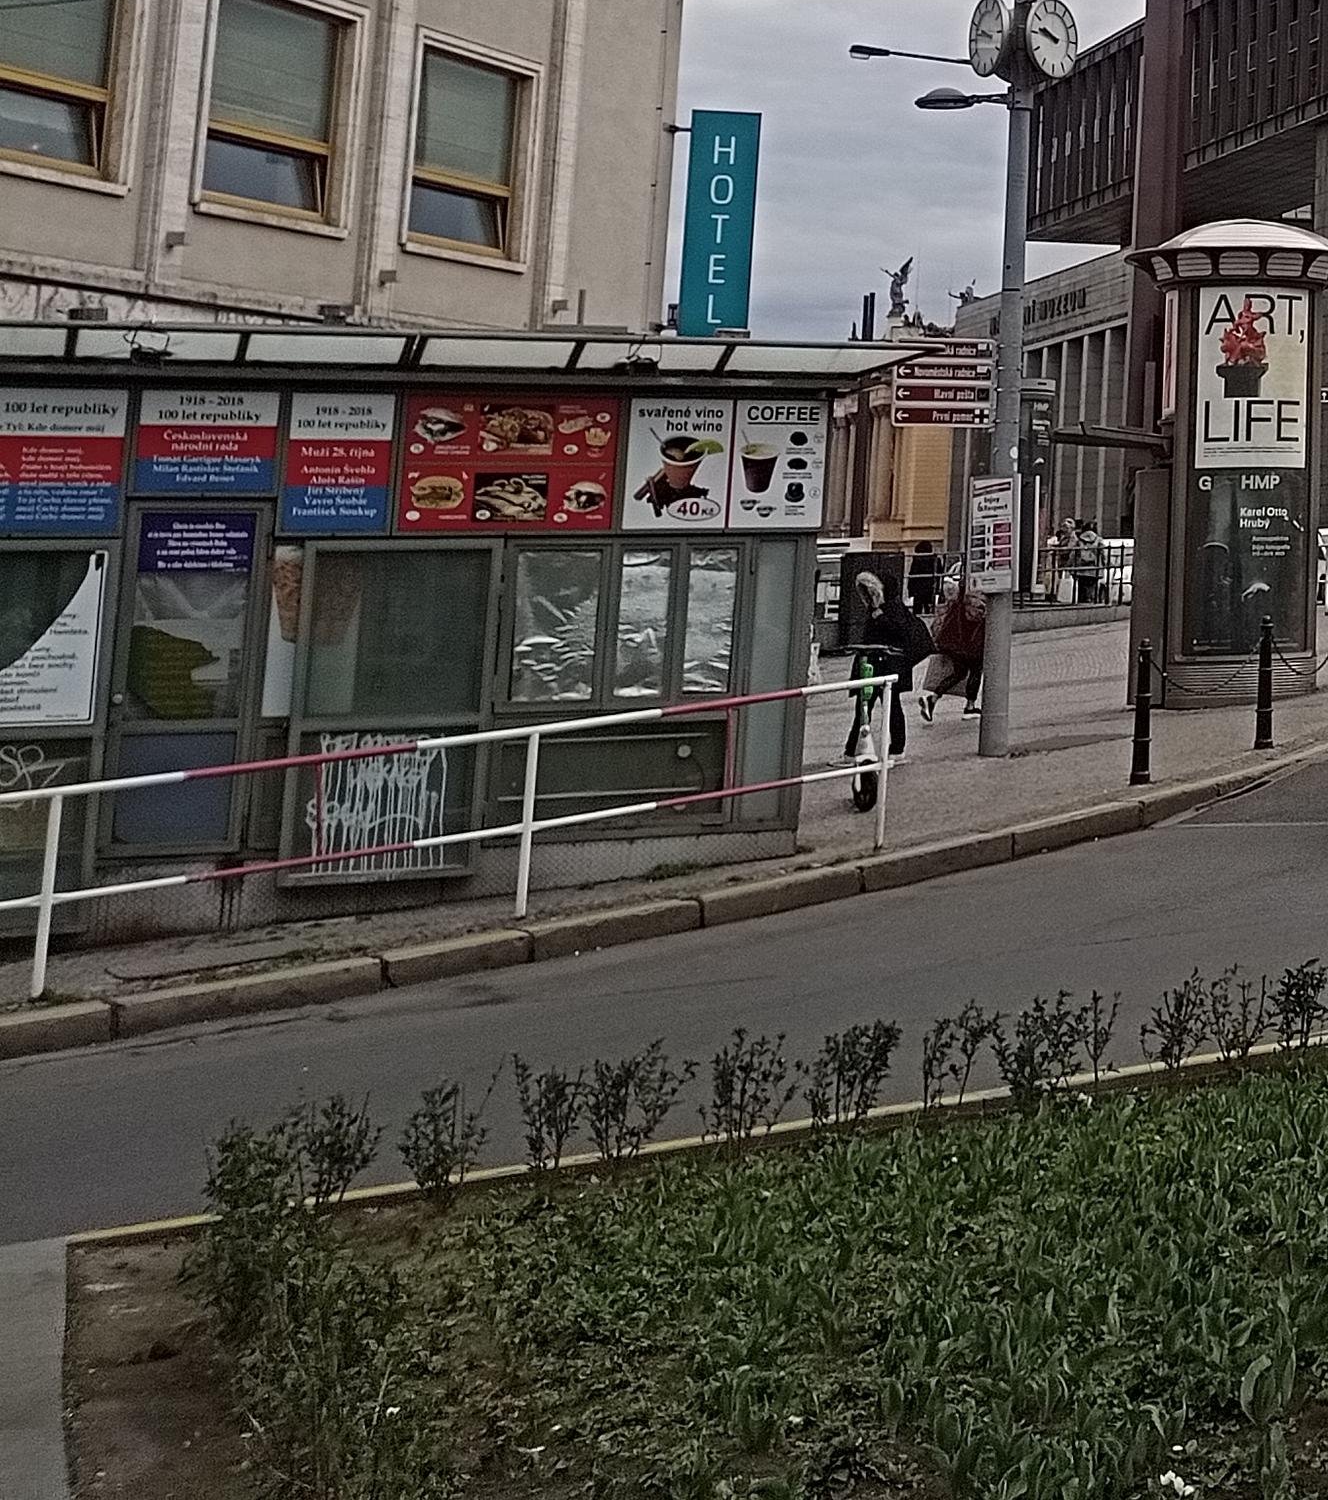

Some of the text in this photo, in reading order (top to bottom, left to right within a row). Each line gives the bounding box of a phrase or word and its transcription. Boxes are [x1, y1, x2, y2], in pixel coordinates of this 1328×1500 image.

[706, 135, 736, 323] HOTEL
[5, 402, 119, 417] 100 let republiky
[158, 410, 261, 423] 100 let republiky
[638, 406, 692, 418] svařené
[747, 406, 821, 421] COFFEE
[298, 420, 388, 432] 100 let republiky
[666, 420, 723, 432] hot wine
[1203, 399, 1300, 442] LIFE
[1198, 474, 1280, 490] G HMP
[677, 501, 700, 516] 40
[1240, 507, 1288, 517] Karel Otto
[1240, 518, 1271, 530] Hrubý
